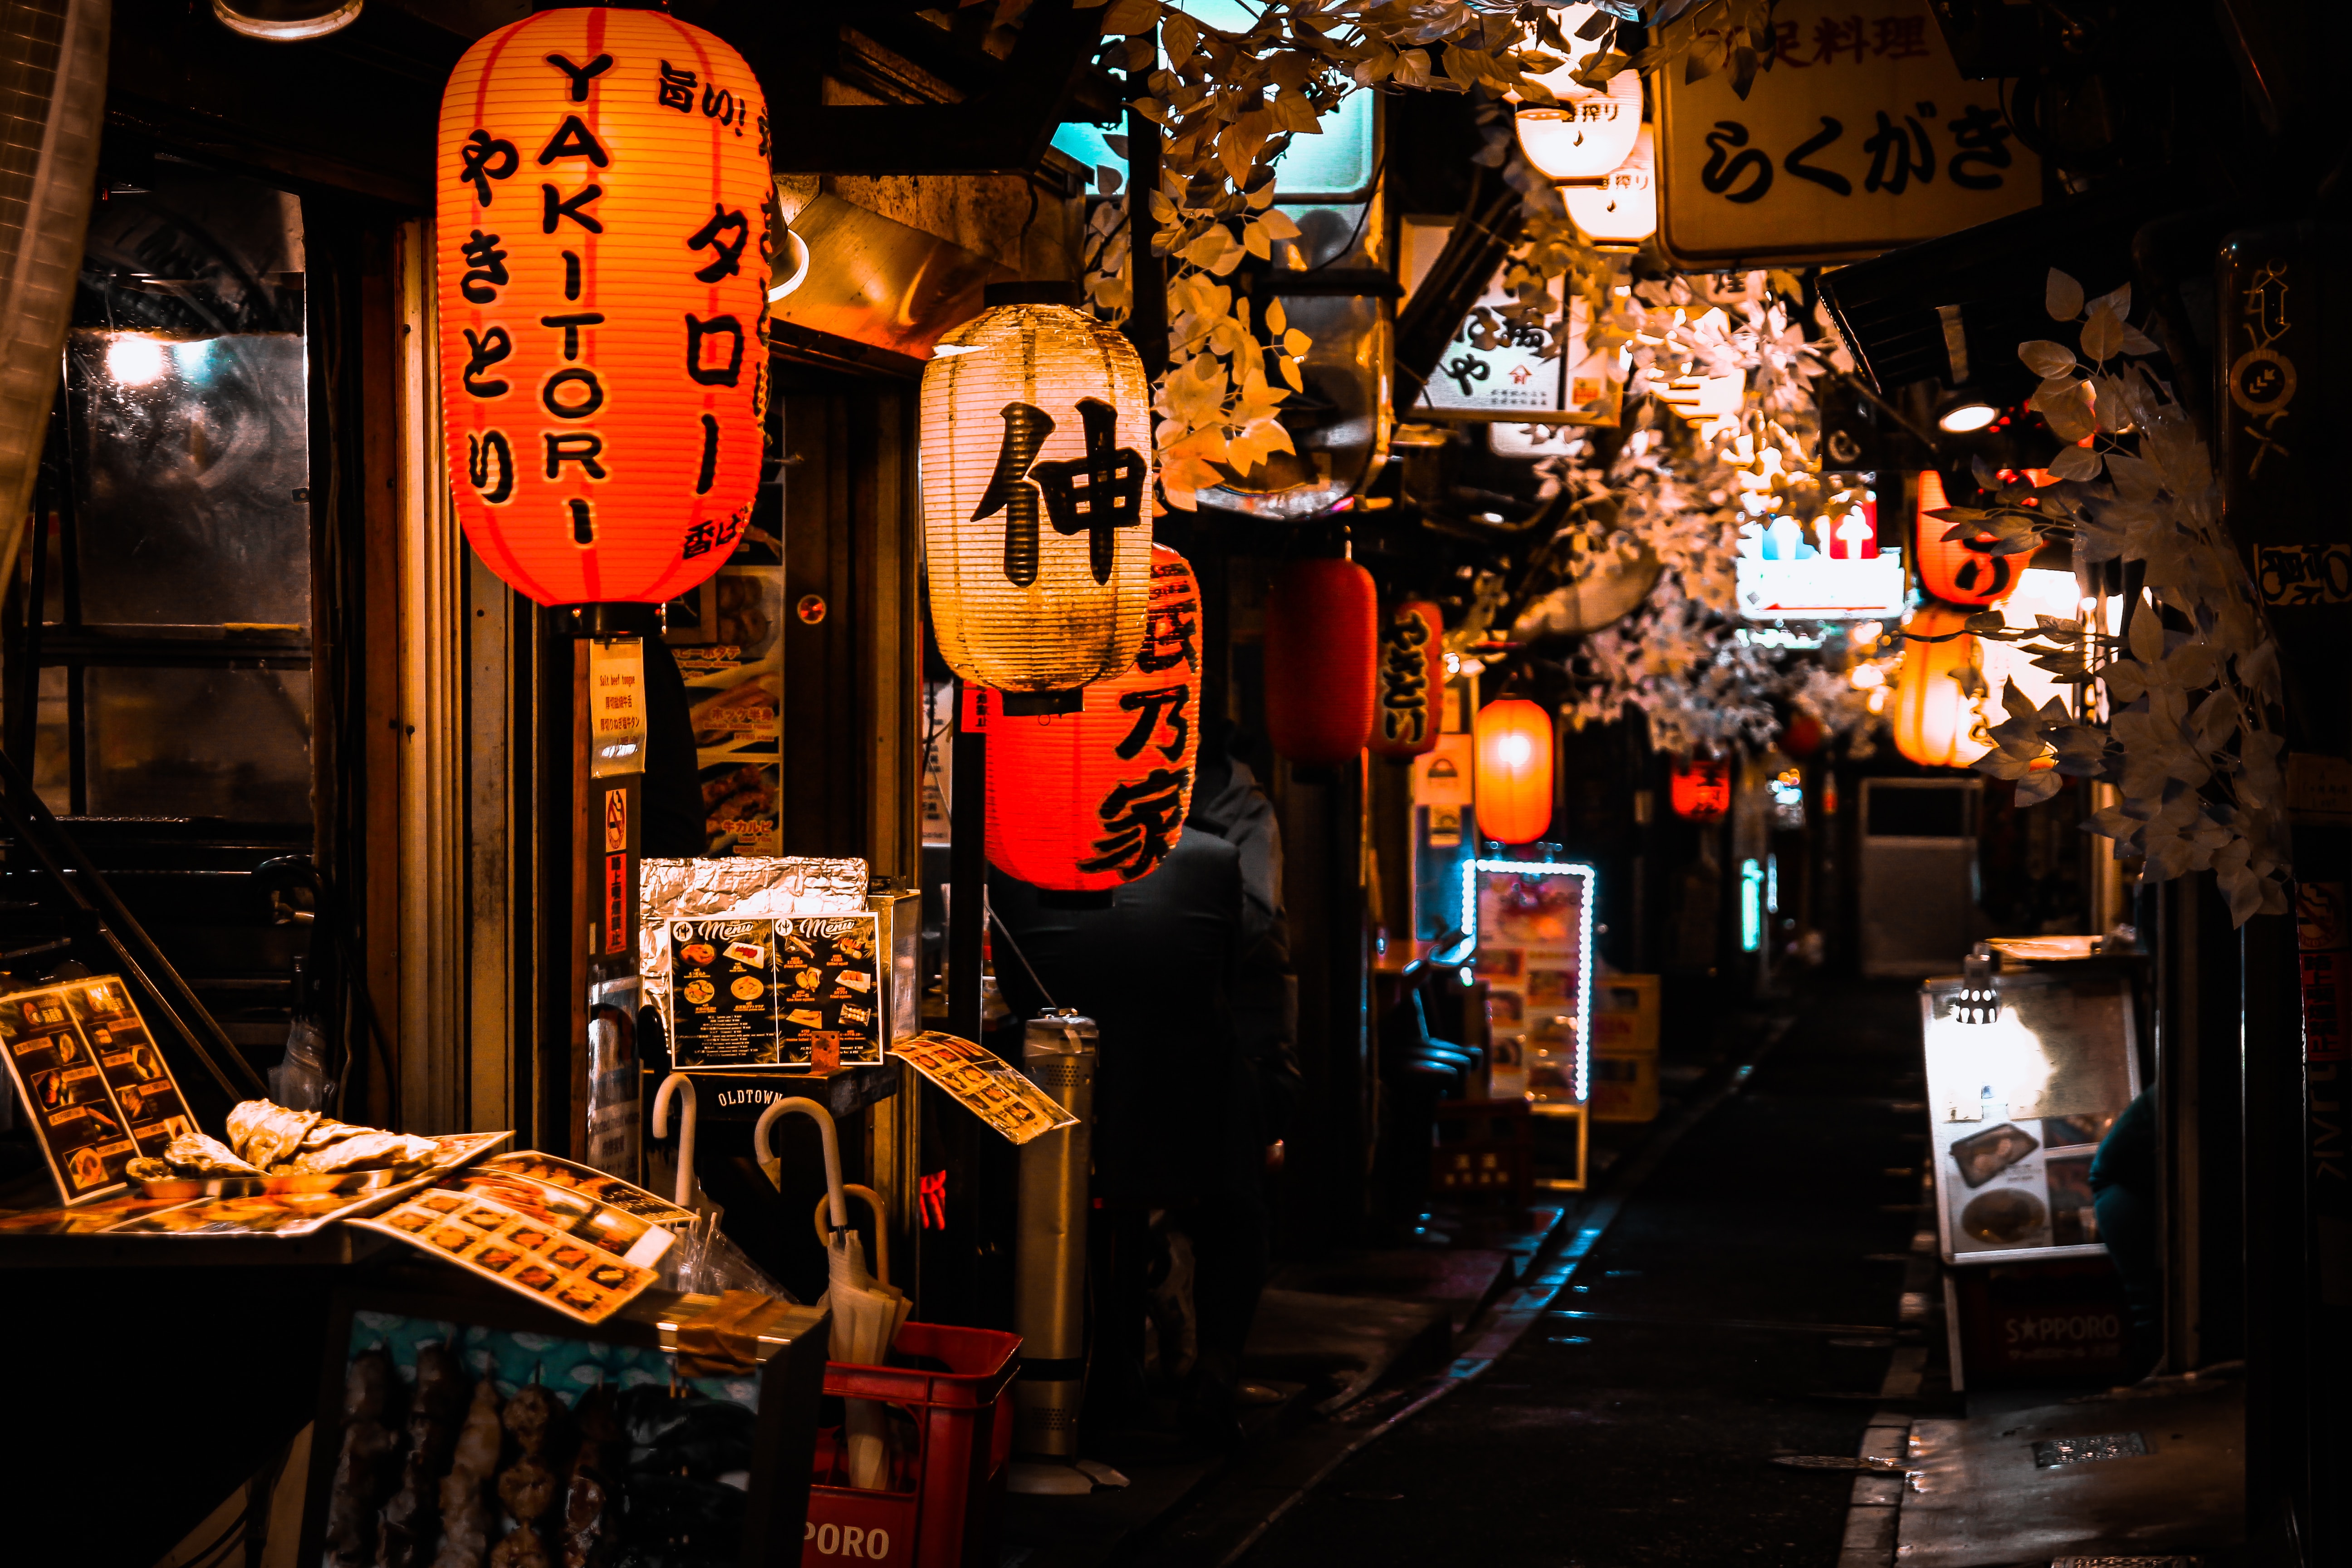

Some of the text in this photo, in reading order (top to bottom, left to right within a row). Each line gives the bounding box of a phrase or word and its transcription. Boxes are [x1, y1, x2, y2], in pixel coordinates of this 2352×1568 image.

[1698, 14, 1930, 69] 足料理
[1562, 103, 1619, 122] 搾り
[1701, 101, 2012, 203] らくがき
[460, 129, 519, 503] やきとり
[538, 54, 613, 544] YAKITORI
[685, 203, 748, 495] タロー
[600, 674, 635, 687] Salt beef tongue
[1382, 610, 1430, 744] やきとり
[698, 921, 754, 941] Menu
[799, 918, 856, 938] Menu
[718, 1089, 783, 1107] OLDTOWN
